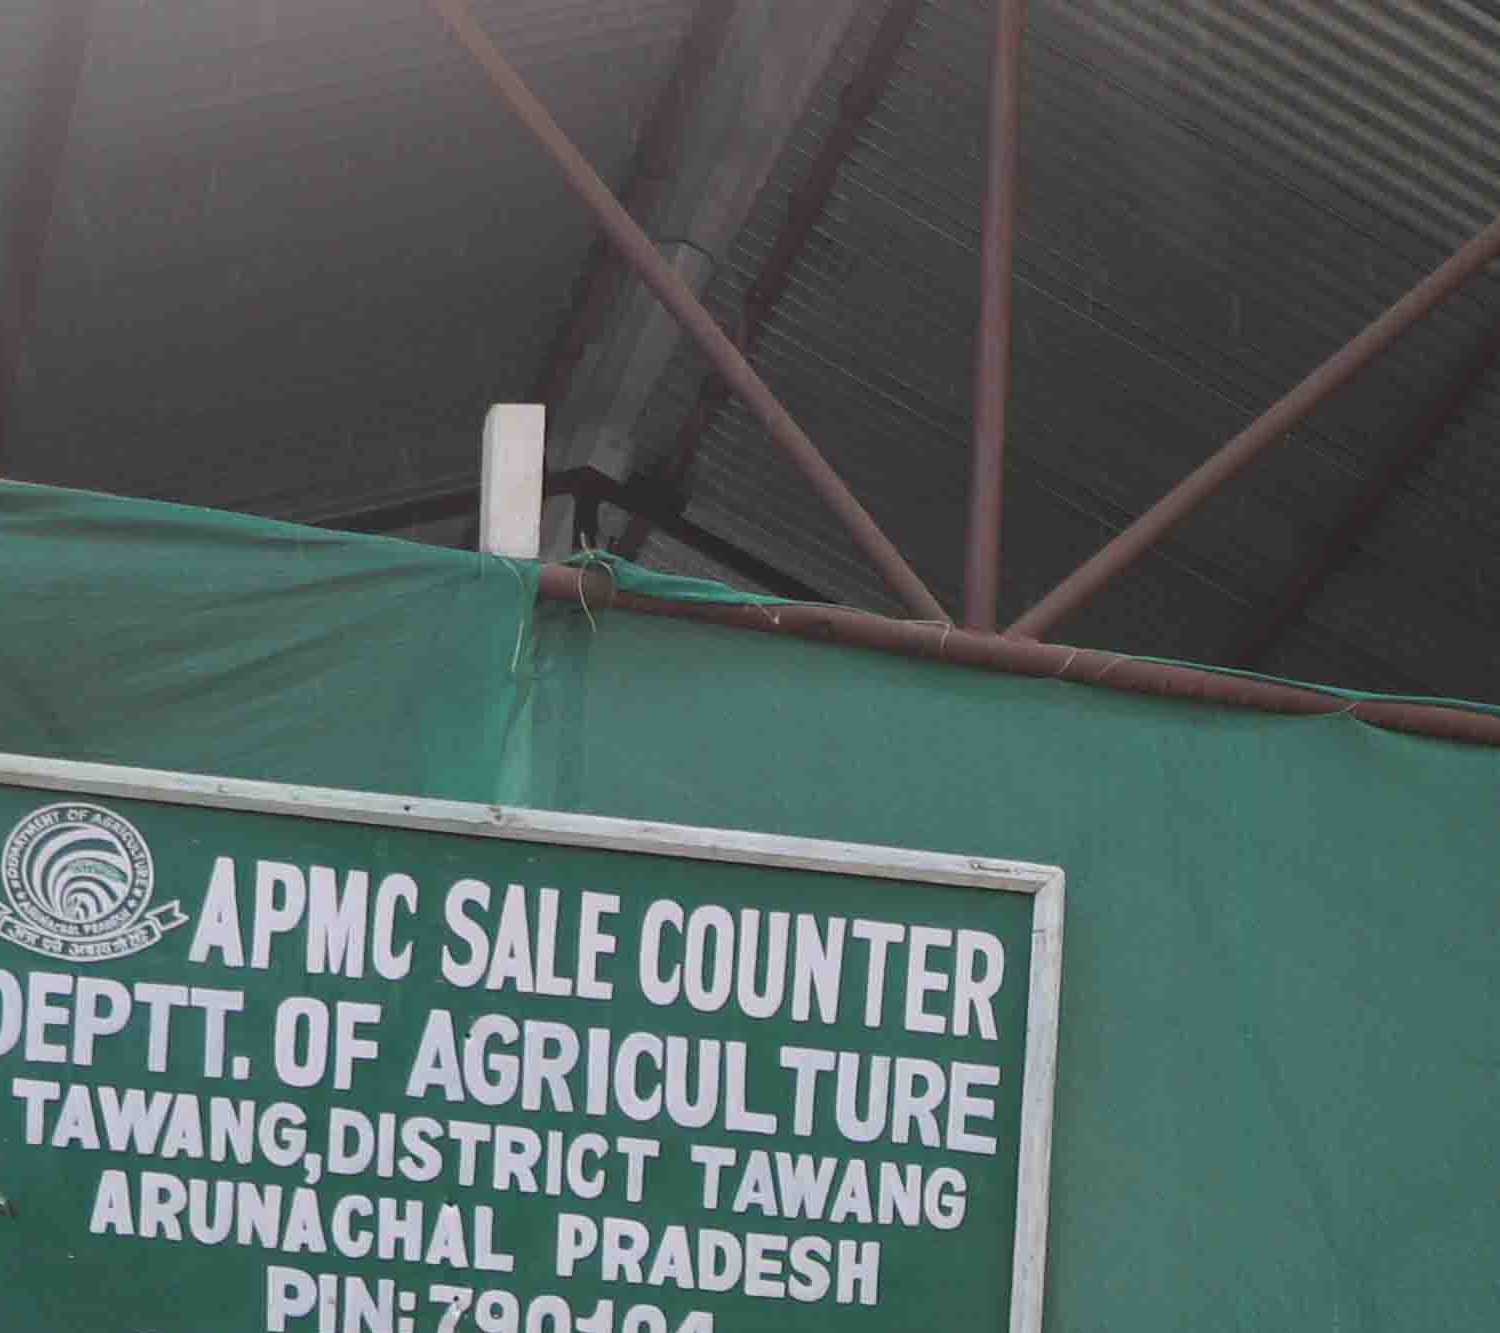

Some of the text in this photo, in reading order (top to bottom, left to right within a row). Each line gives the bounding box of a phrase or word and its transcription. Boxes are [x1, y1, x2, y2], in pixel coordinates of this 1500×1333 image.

[188, 855, 1006, 1041] APMC SALE COUNTER
[274, 996, 380, 1091] OF
[406, 1009, 1000, 1153] AGRICULTURE
[91, 1169, 880, 1305] ARUNACHAL PRADESH
[691, 1145, 967, 1230] TAWANG
